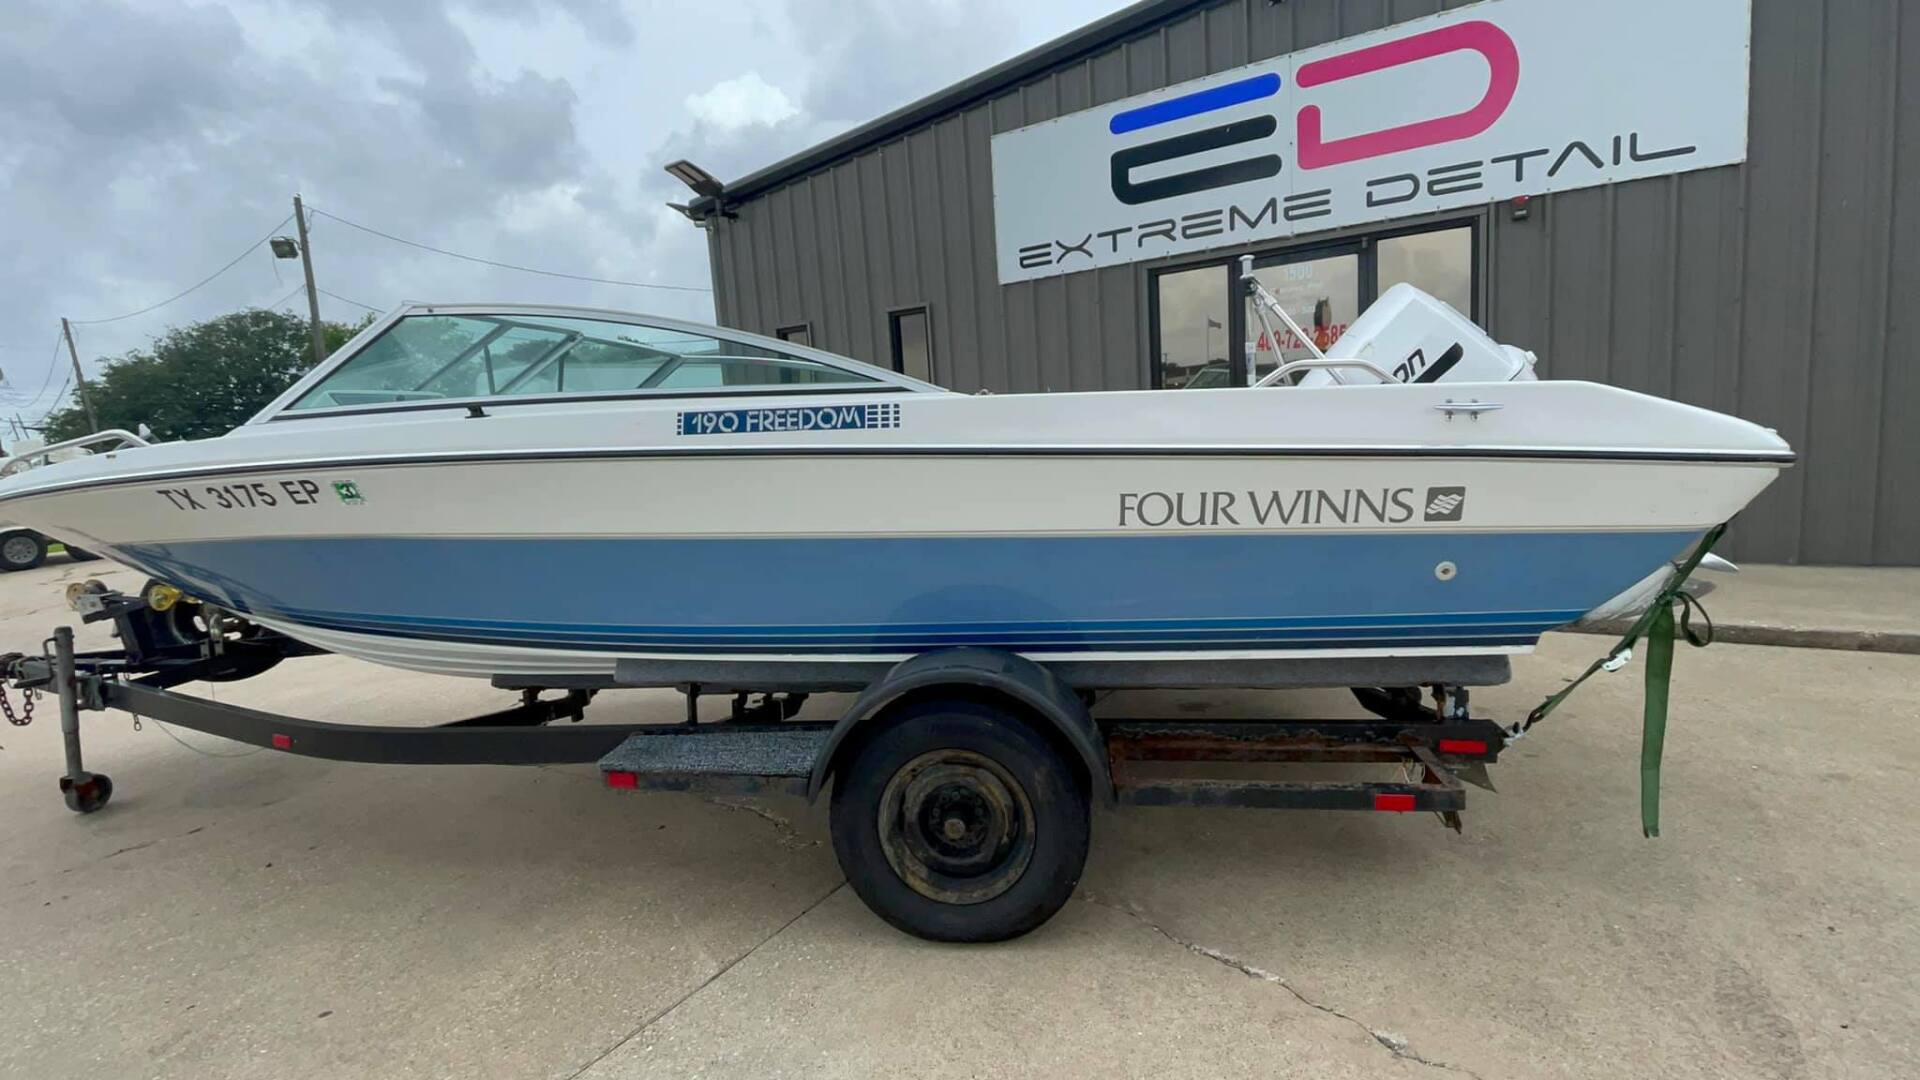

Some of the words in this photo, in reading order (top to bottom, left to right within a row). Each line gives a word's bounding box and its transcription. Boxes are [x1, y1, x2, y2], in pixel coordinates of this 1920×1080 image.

[1109, 20, 1521, 206] ED
[1018, 188, 1334, 270] EXTREME
[1366, 132, 1697, 208] DETAIL
[691, 412, 739, 434] 190
[746, 406, 862, 431] FREEDOM
[156, 489, 207, 511] TX
[206, 483, 277, 509] 3175
[279, 479, 320, 505] EP
[1118, 491, 1240, 527] FOUR
[1247, 487, 1415, 526] WINNS
